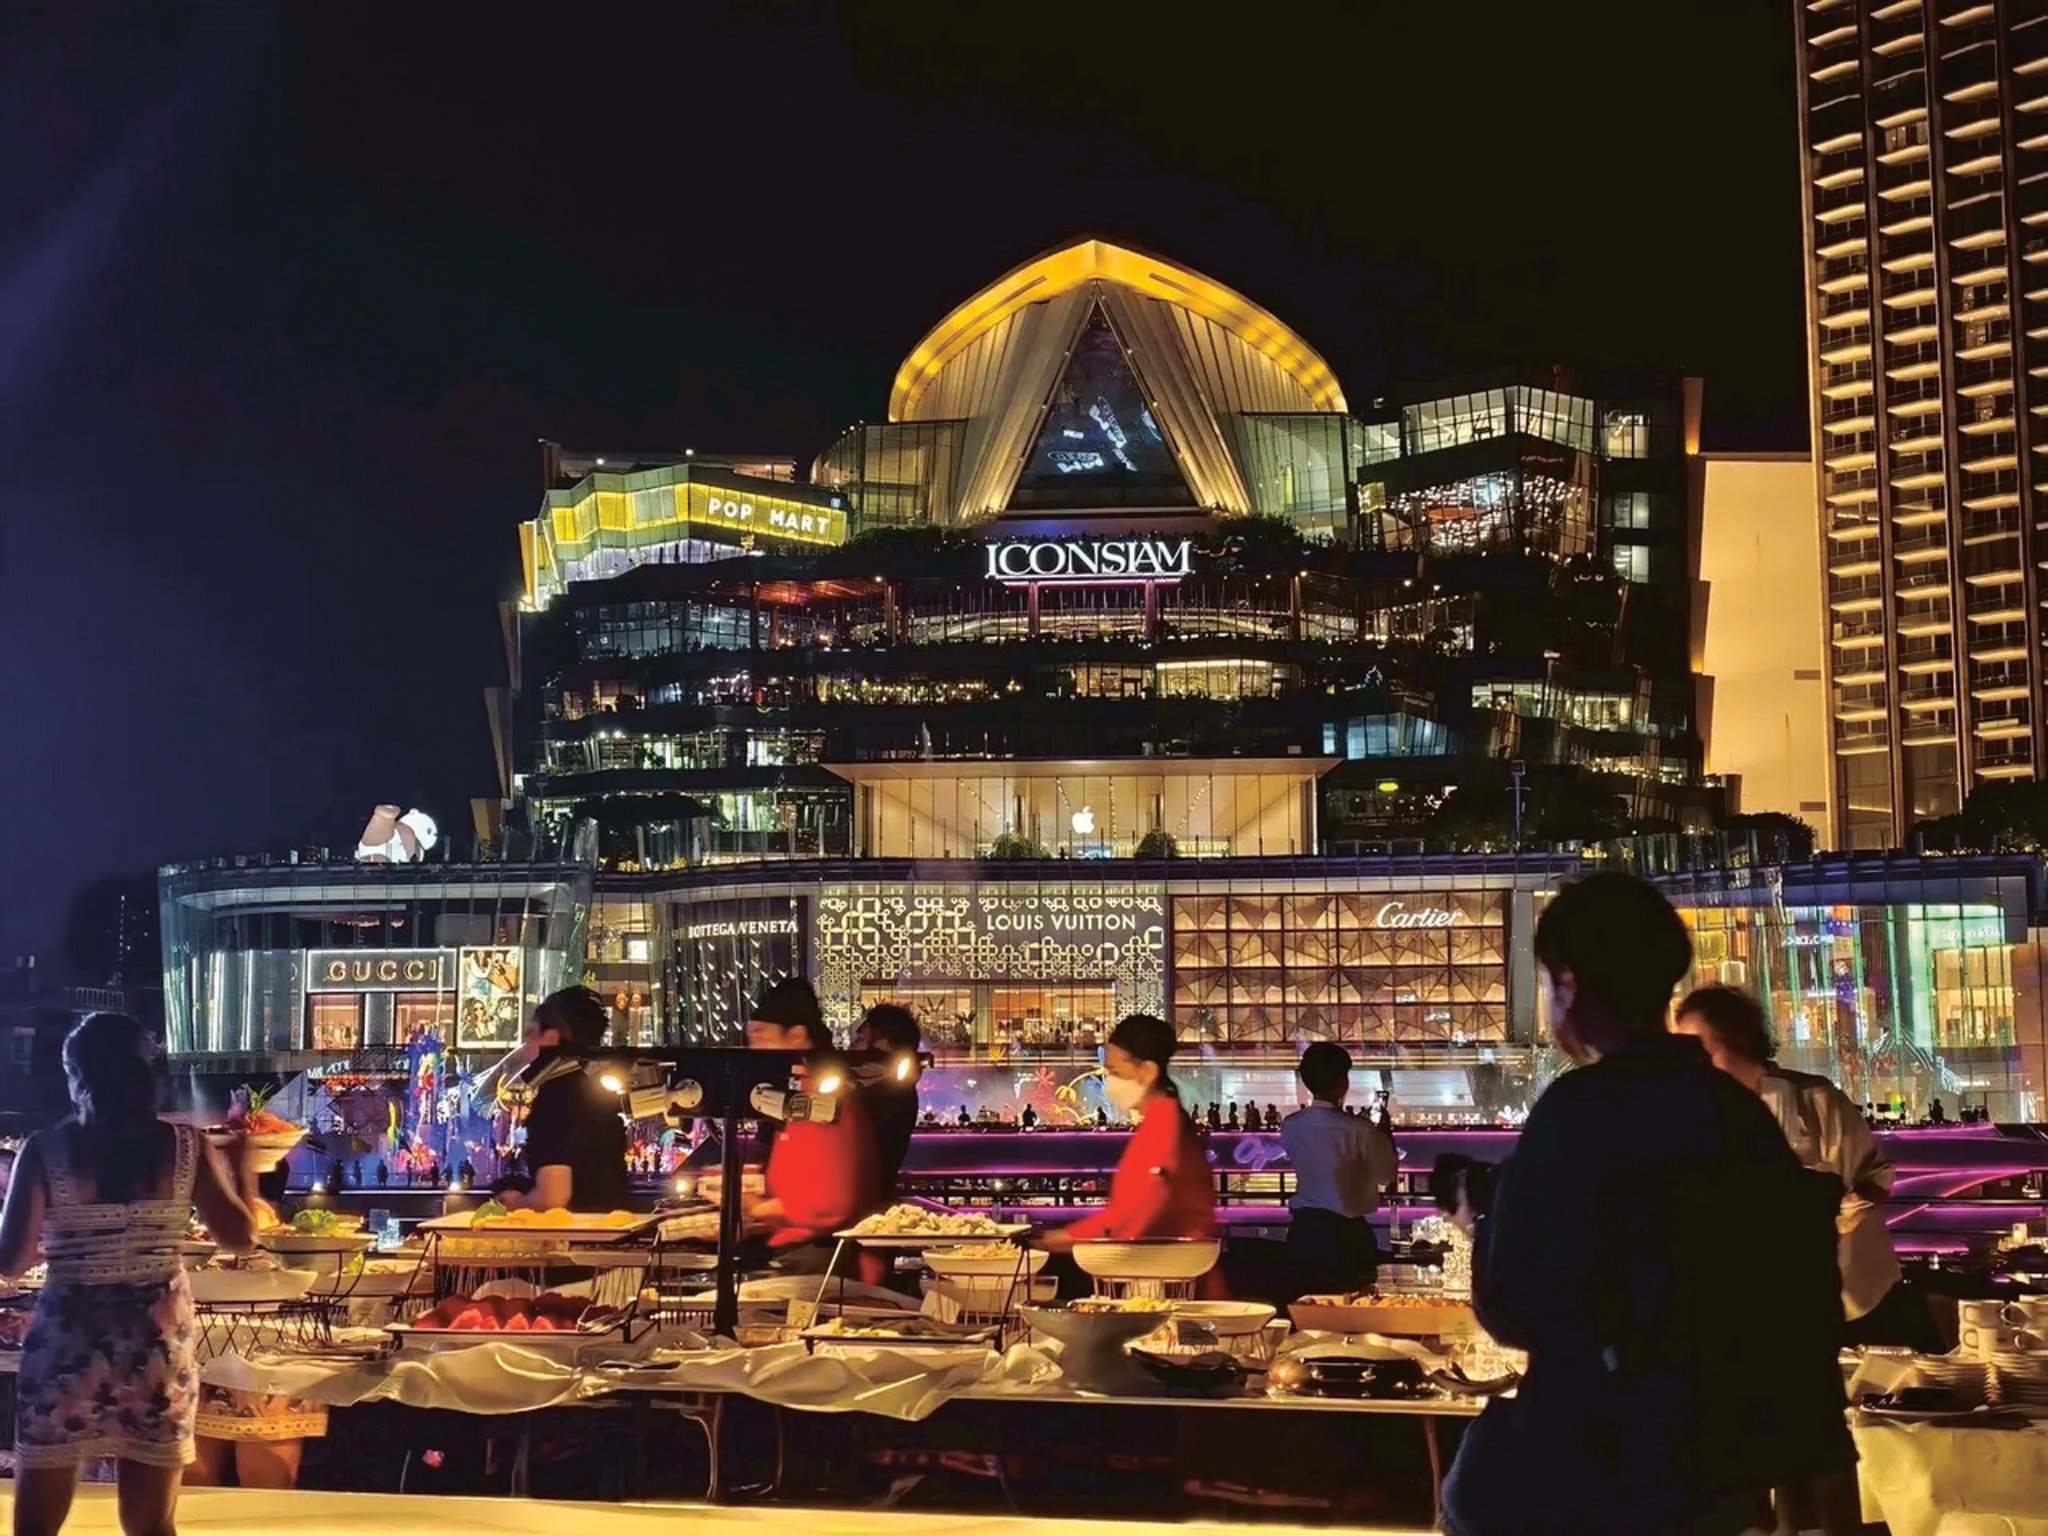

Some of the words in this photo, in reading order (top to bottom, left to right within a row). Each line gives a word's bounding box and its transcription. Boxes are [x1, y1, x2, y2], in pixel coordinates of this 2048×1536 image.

[708, 497, 753, 520] POP
[769, 509, 829, 535] MART
[984, 541, 1193, 578] ICONSIAM
[987, 914, 1044, 931] LOUIS
[1051, 914, 1136, 931] VUITTON
[1377, 902, 1463, 928] Cartier
[688, 922, 735, 938] BOTTEGA
[738, 920, 798, 934] VENETA
[327, 960, 438, 982] GUCCI
